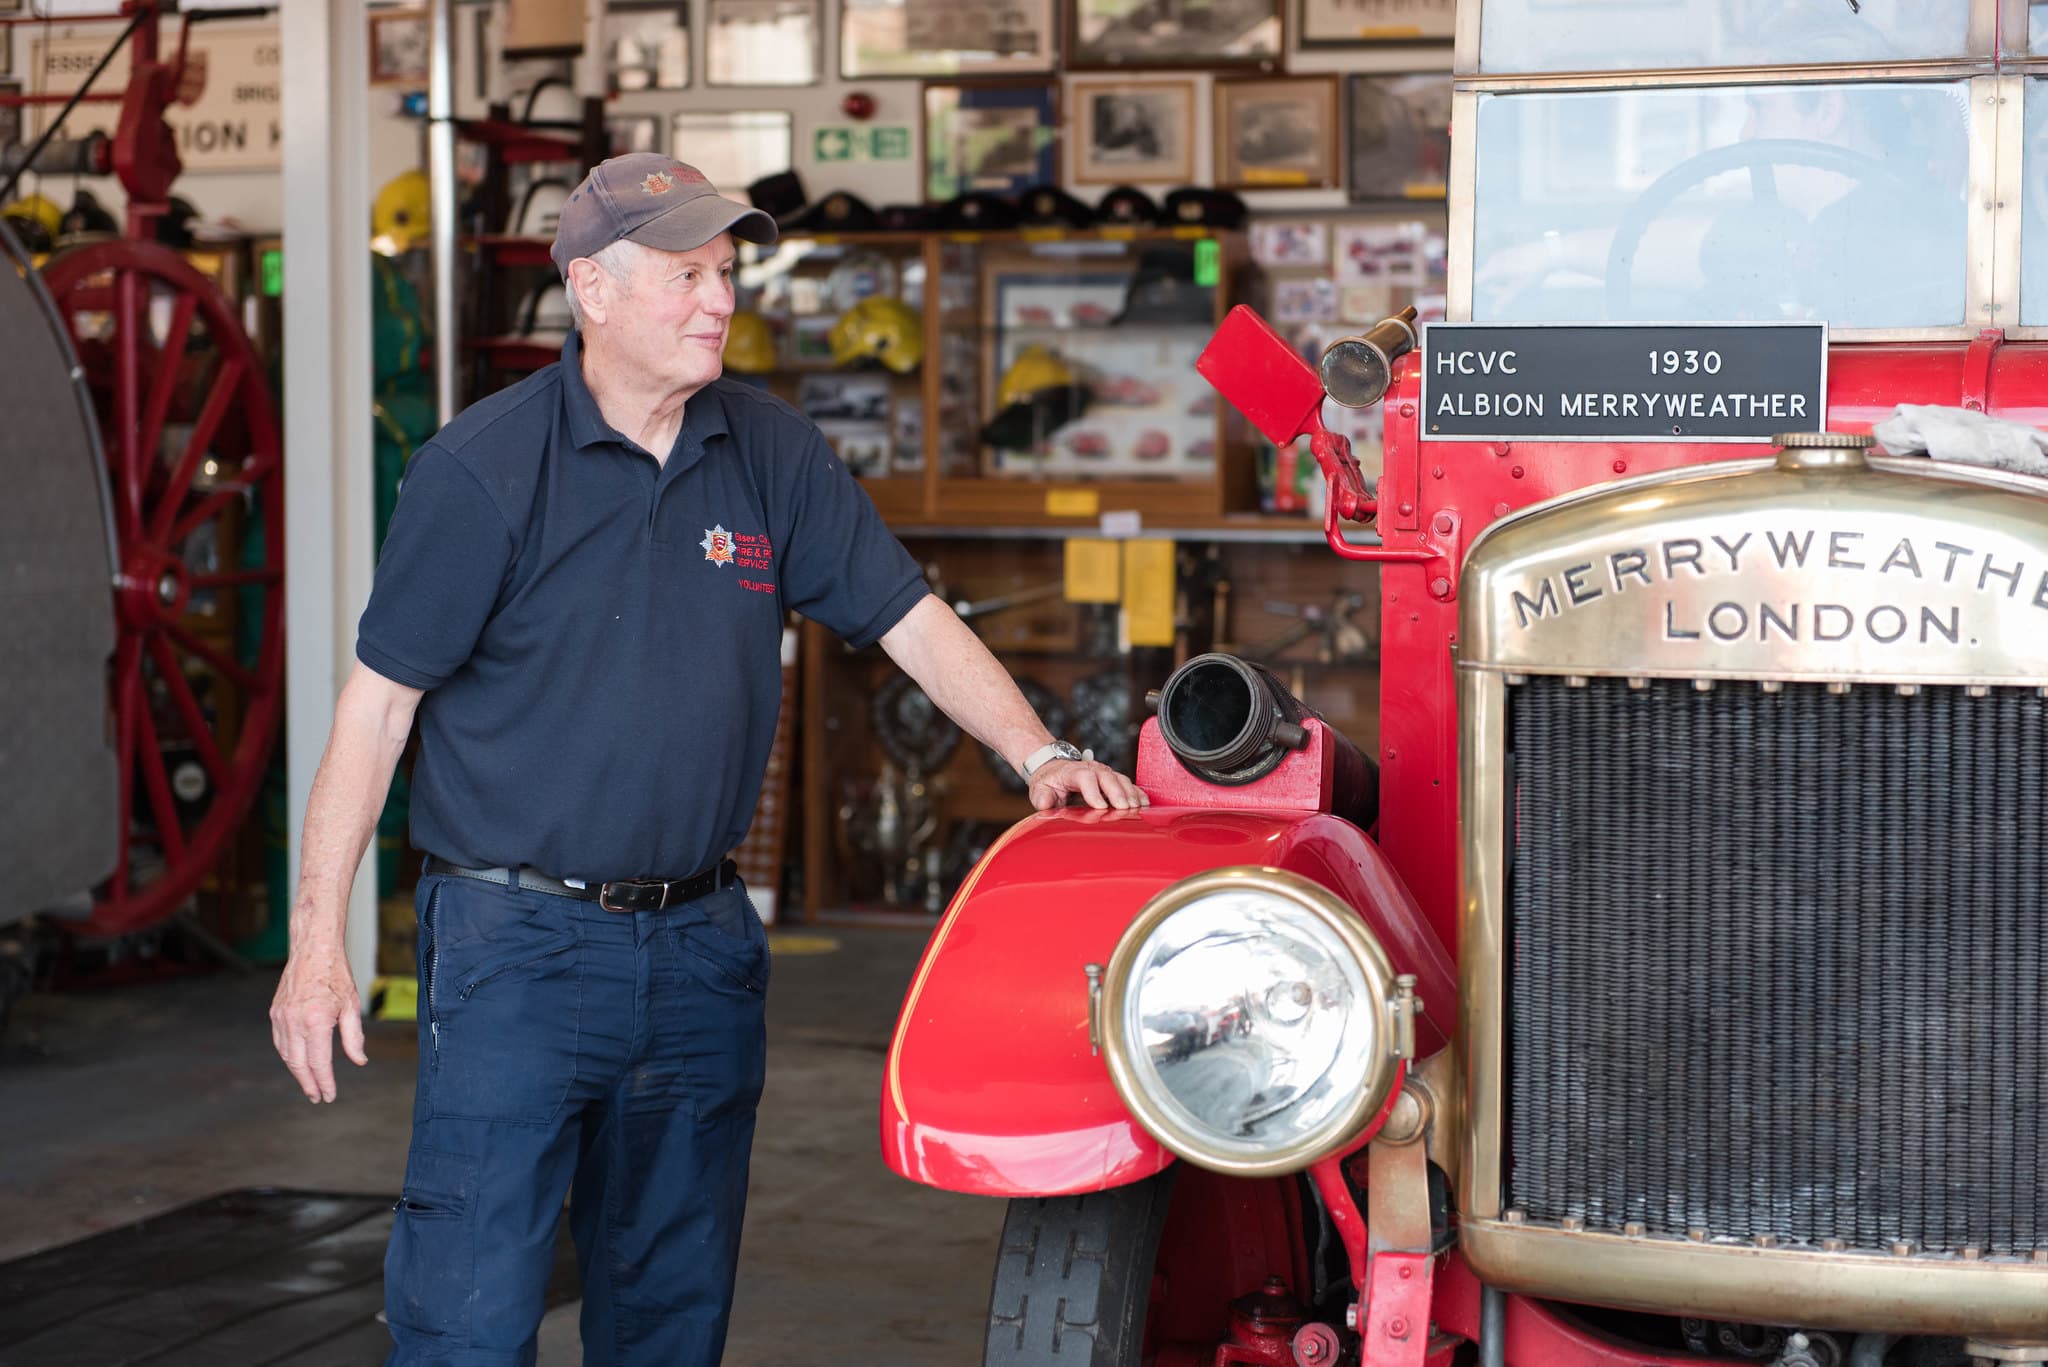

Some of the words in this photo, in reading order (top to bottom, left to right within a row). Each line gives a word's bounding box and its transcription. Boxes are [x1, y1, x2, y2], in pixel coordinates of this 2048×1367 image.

[47, 53, 100, 74] ESSE
[174, 121, 247, 153] ION
[1436, 351, 1518, 375] HCVC
[1648, 350, 1722, 376] 1930
[1436, 393, 1544, 417] ALBION
[1560, 393, 1808, 418] MERRYWEATHER
[1665, 600, 1978, 645] LONDON.
